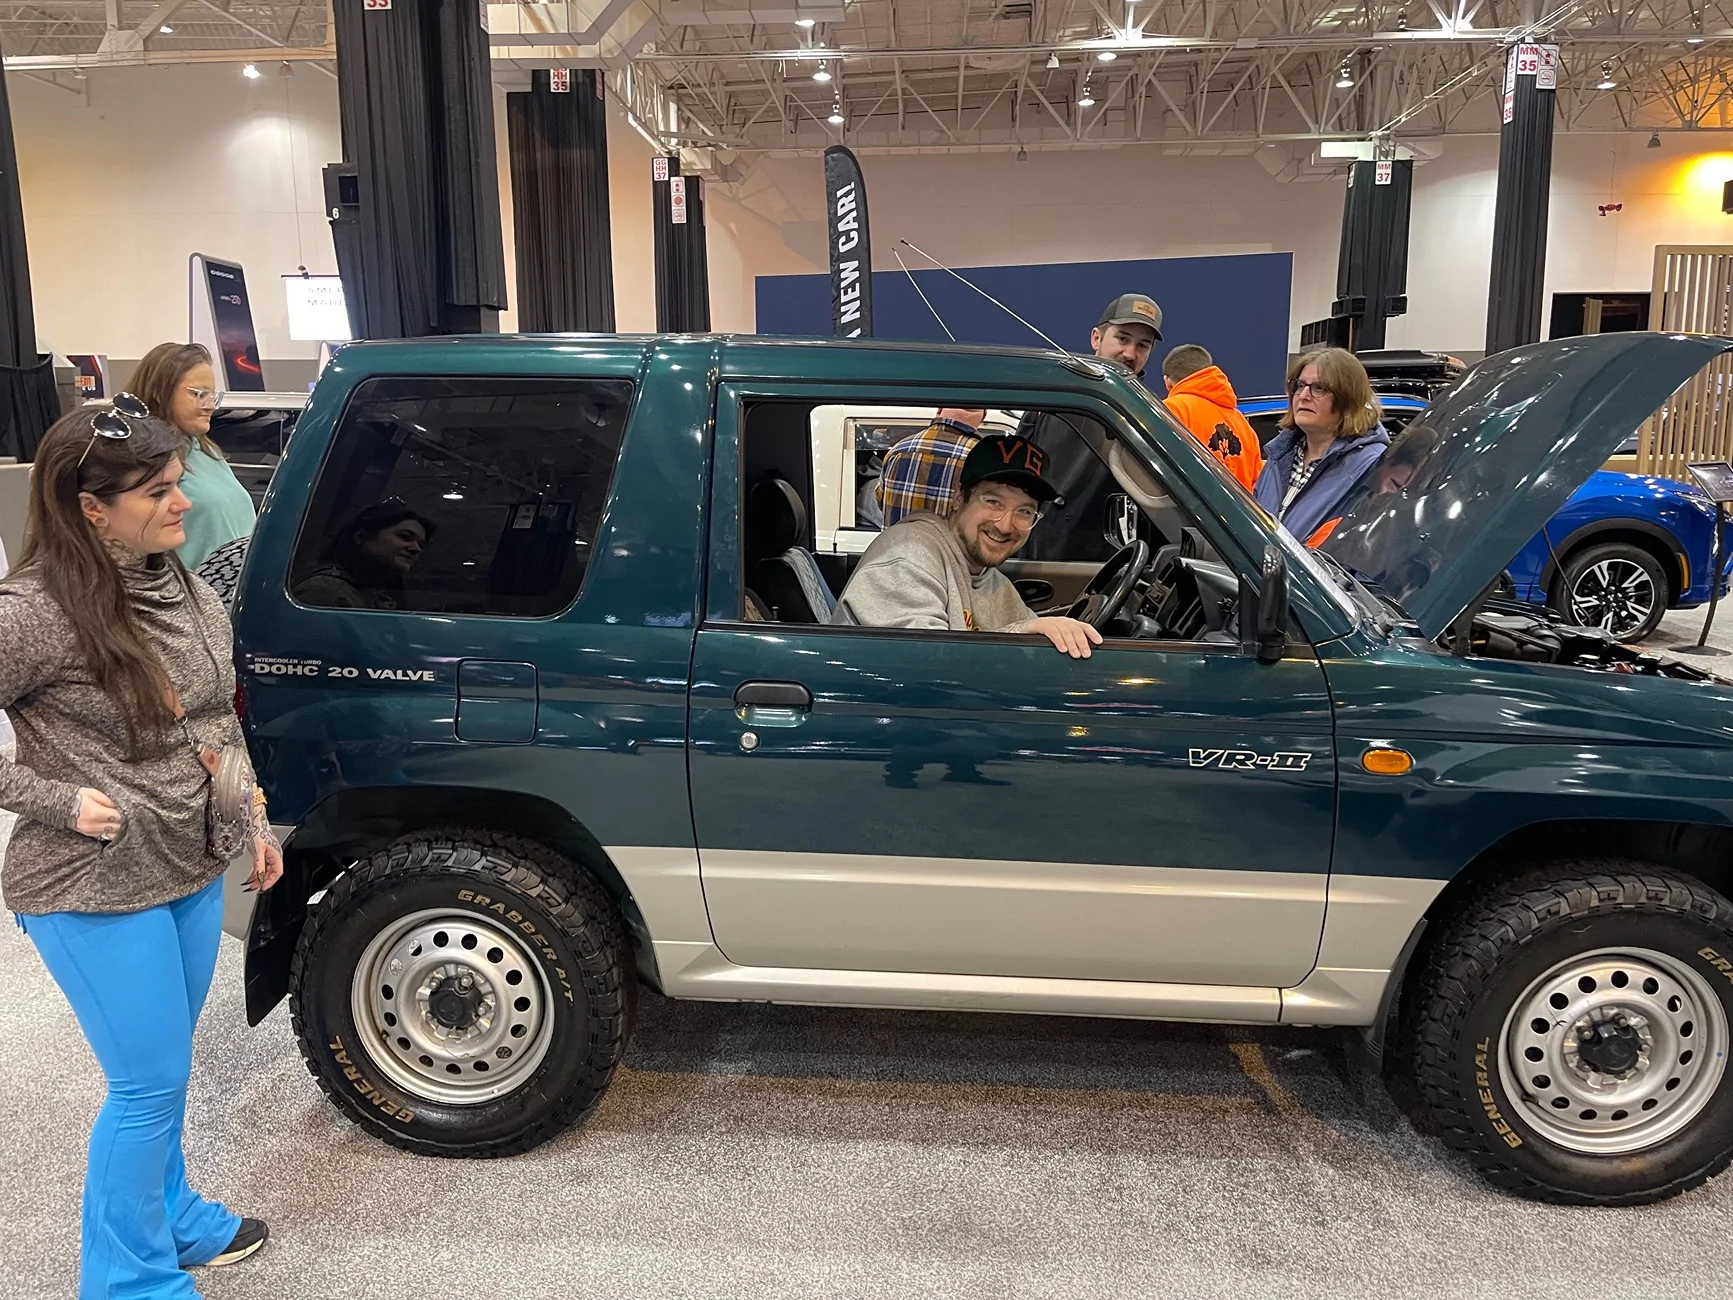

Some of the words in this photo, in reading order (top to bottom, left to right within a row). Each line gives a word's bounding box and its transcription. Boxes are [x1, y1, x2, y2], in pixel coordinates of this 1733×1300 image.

[1520, 46, 1538, 55] MM
[1518, 60, 1537, 71] 35
[552, 71, 568, 80] HH
[552, 81, 568, 91] 35
[1377, 173, 1390, 182] 37
[332, 207, 340, 219] 6
[837, 181, 859, 253] CAR!
[840, 260, 862, 324] NEW
[996, 440, 1043, 477] VG
[254, 657, 298, 665] INTERCOOLER
[254, 663, 319, 676] DOHC
[327, 667, 359, 678] 20
[366, 668, 435, 682] VALVE
[457, 889, 558, 960] GRABBER
[555, 966, 574, 1002] A/T
[328, 1034, 415, 1123] GENERAL
[1474, 1036, 1523, 1148] GENERAL
